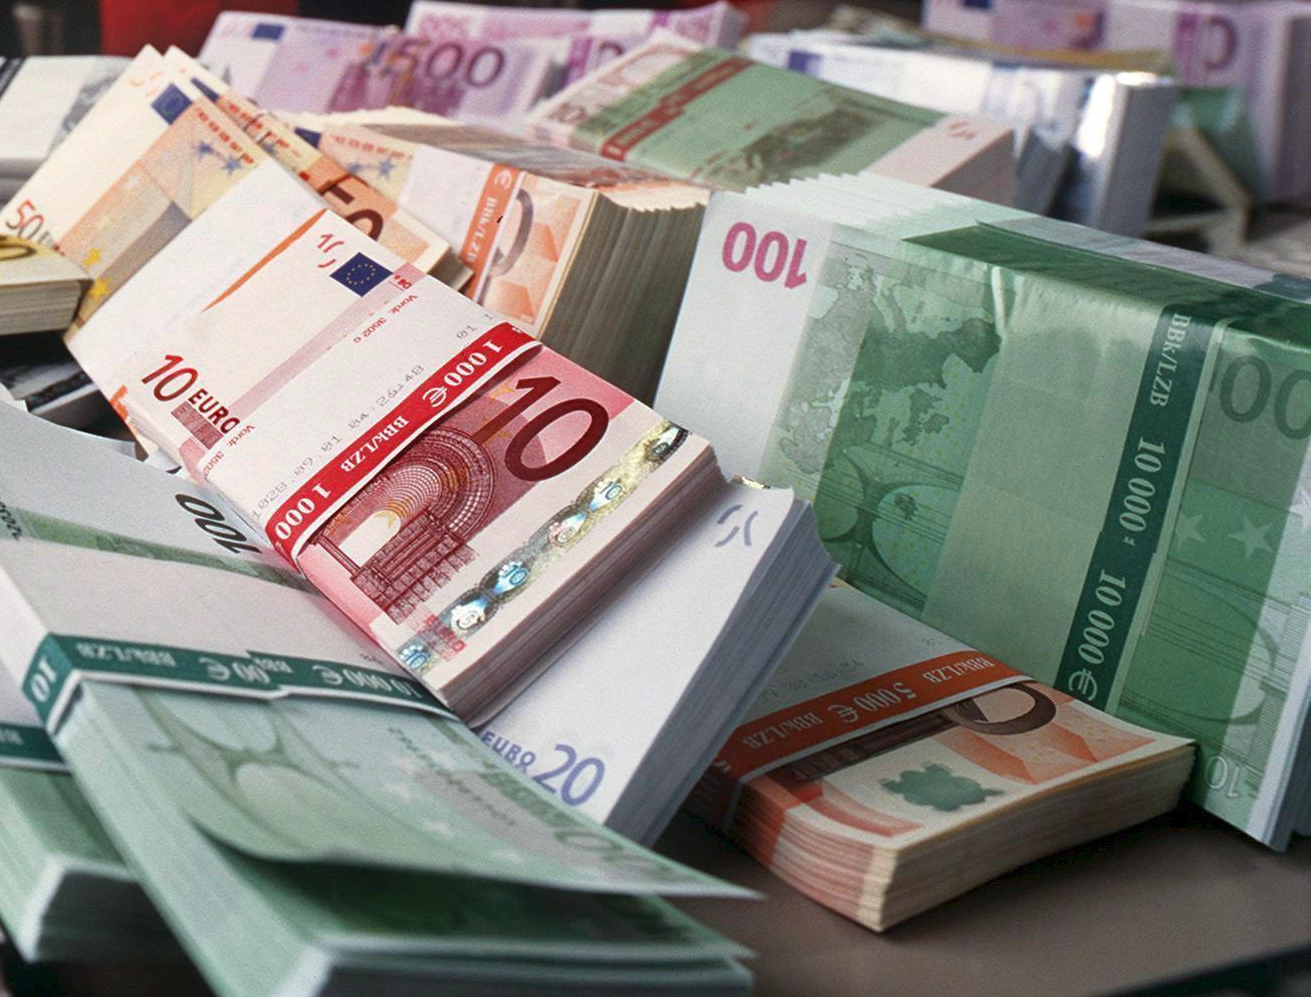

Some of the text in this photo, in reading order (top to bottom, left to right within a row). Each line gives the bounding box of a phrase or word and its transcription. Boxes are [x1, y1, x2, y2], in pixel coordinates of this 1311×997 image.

[5, 200, 46, 235] 50
[722, 222, 806, 289] 100
[1150, 312, 1193, 407] BBk/LZB
[141, 353, 241, 436] 10 EURO
[340, 415, 411, 473] BBk/LZB
[469, 375, 610, 482] 10
[533, 742, 606, 805] 20
